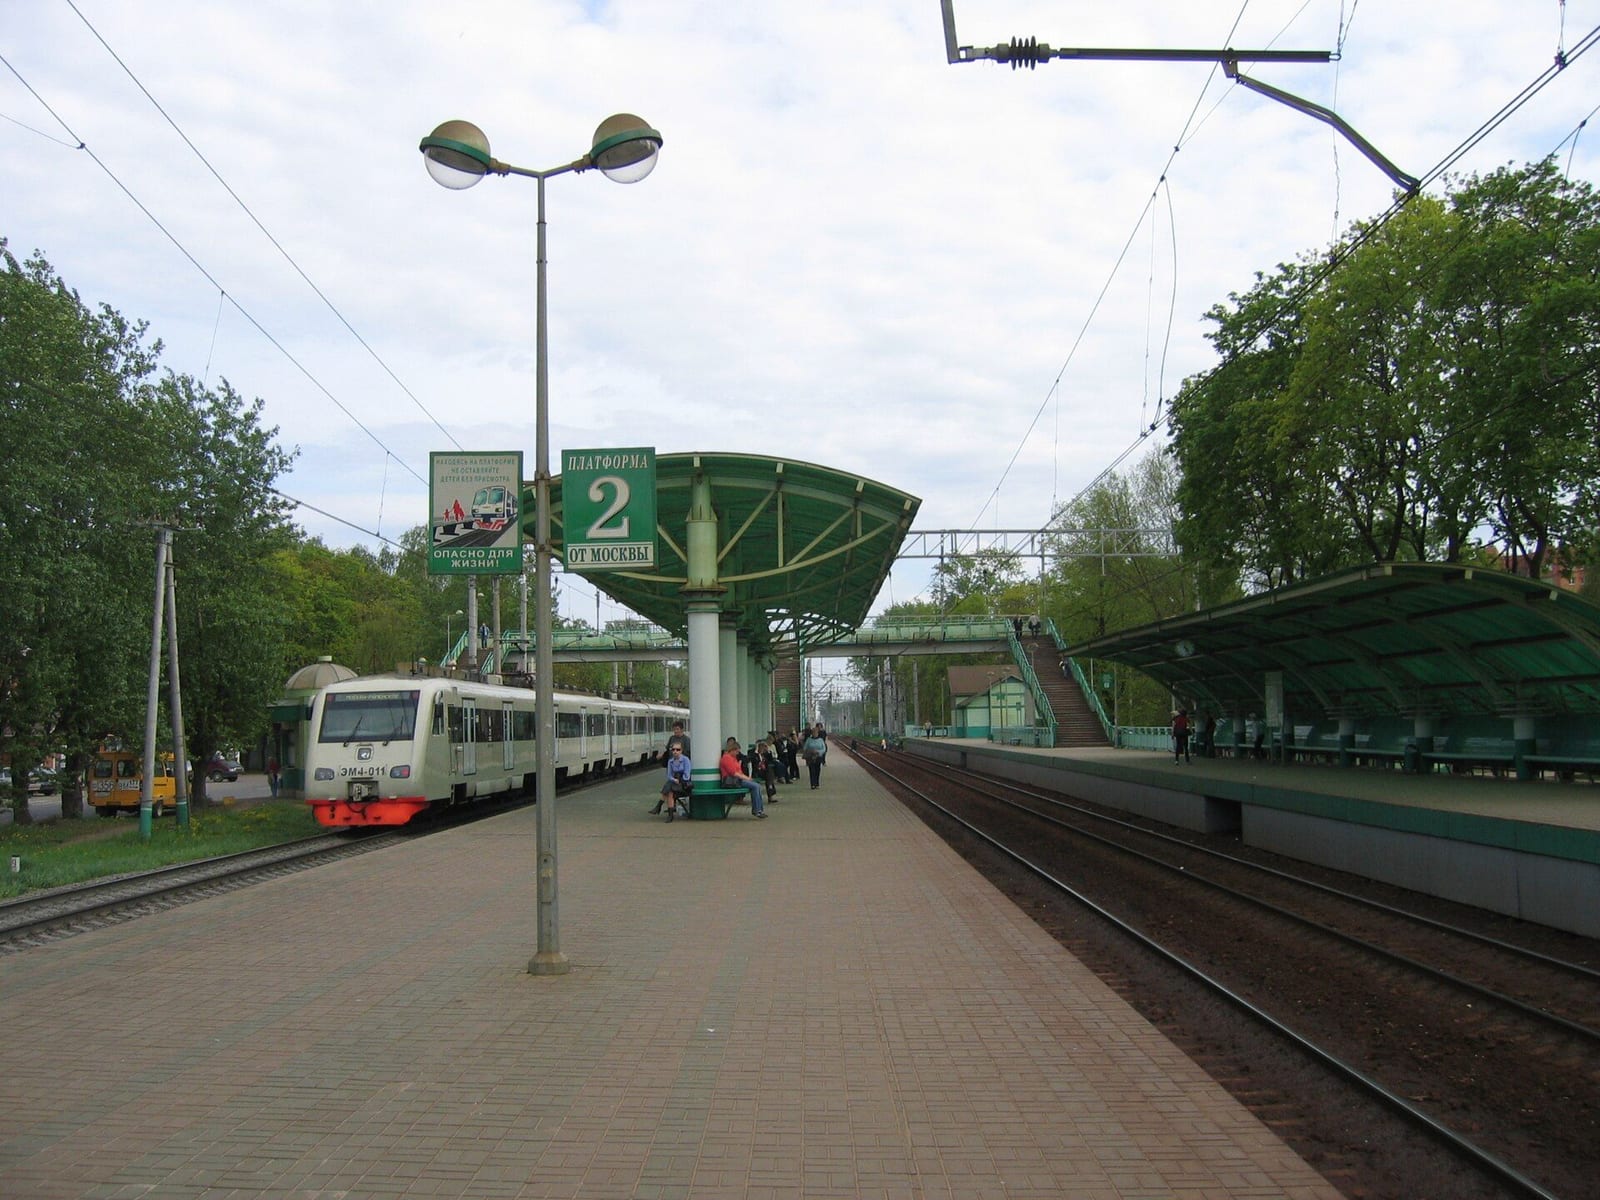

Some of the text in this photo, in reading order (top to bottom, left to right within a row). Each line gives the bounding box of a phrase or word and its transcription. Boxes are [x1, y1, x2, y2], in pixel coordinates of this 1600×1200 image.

[568, 454, 648, 471] ПЛАТФОРМА
[586, 474, 631, 539] 2
[433, 549, 513, 559] ОПАСНО ДЛЯ
[569, 546, 649, 563] ОТ МОСКВЫ
[451, 559, 499, 568] ЖИЗНИ!
[340, 766, 385, 777] ЭМ4-011
